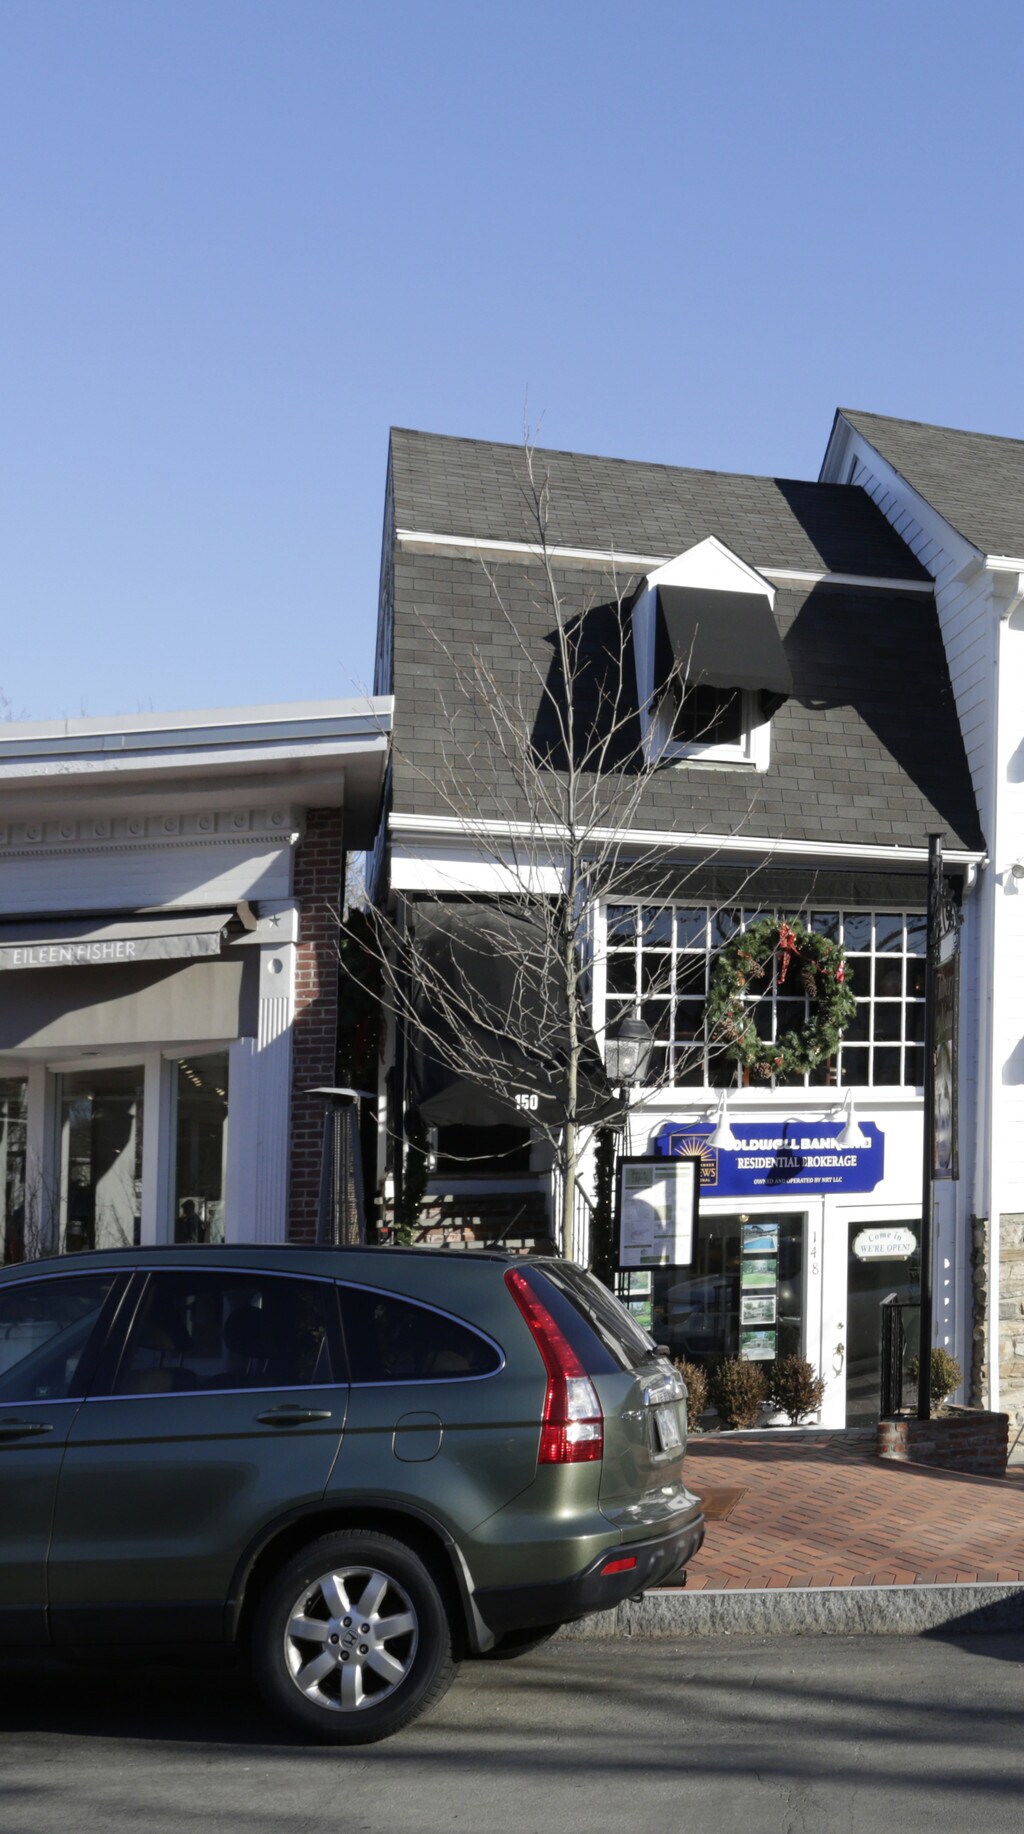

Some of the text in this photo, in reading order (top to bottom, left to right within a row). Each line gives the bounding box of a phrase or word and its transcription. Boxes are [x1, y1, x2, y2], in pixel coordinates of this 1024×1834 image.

[13, 941, 136, 965] EILEEN FISHER
[514, 1094, 539, 1111] 150
[724, 1138, 800, 1151] OLDWELL
[737, 1155, 857, 1169] RESIDENTIAL BROKERAGE
[868, 1231, 902, 1242] Come in
[860, 1243, 911, 1253] WE'RE OPEN!
